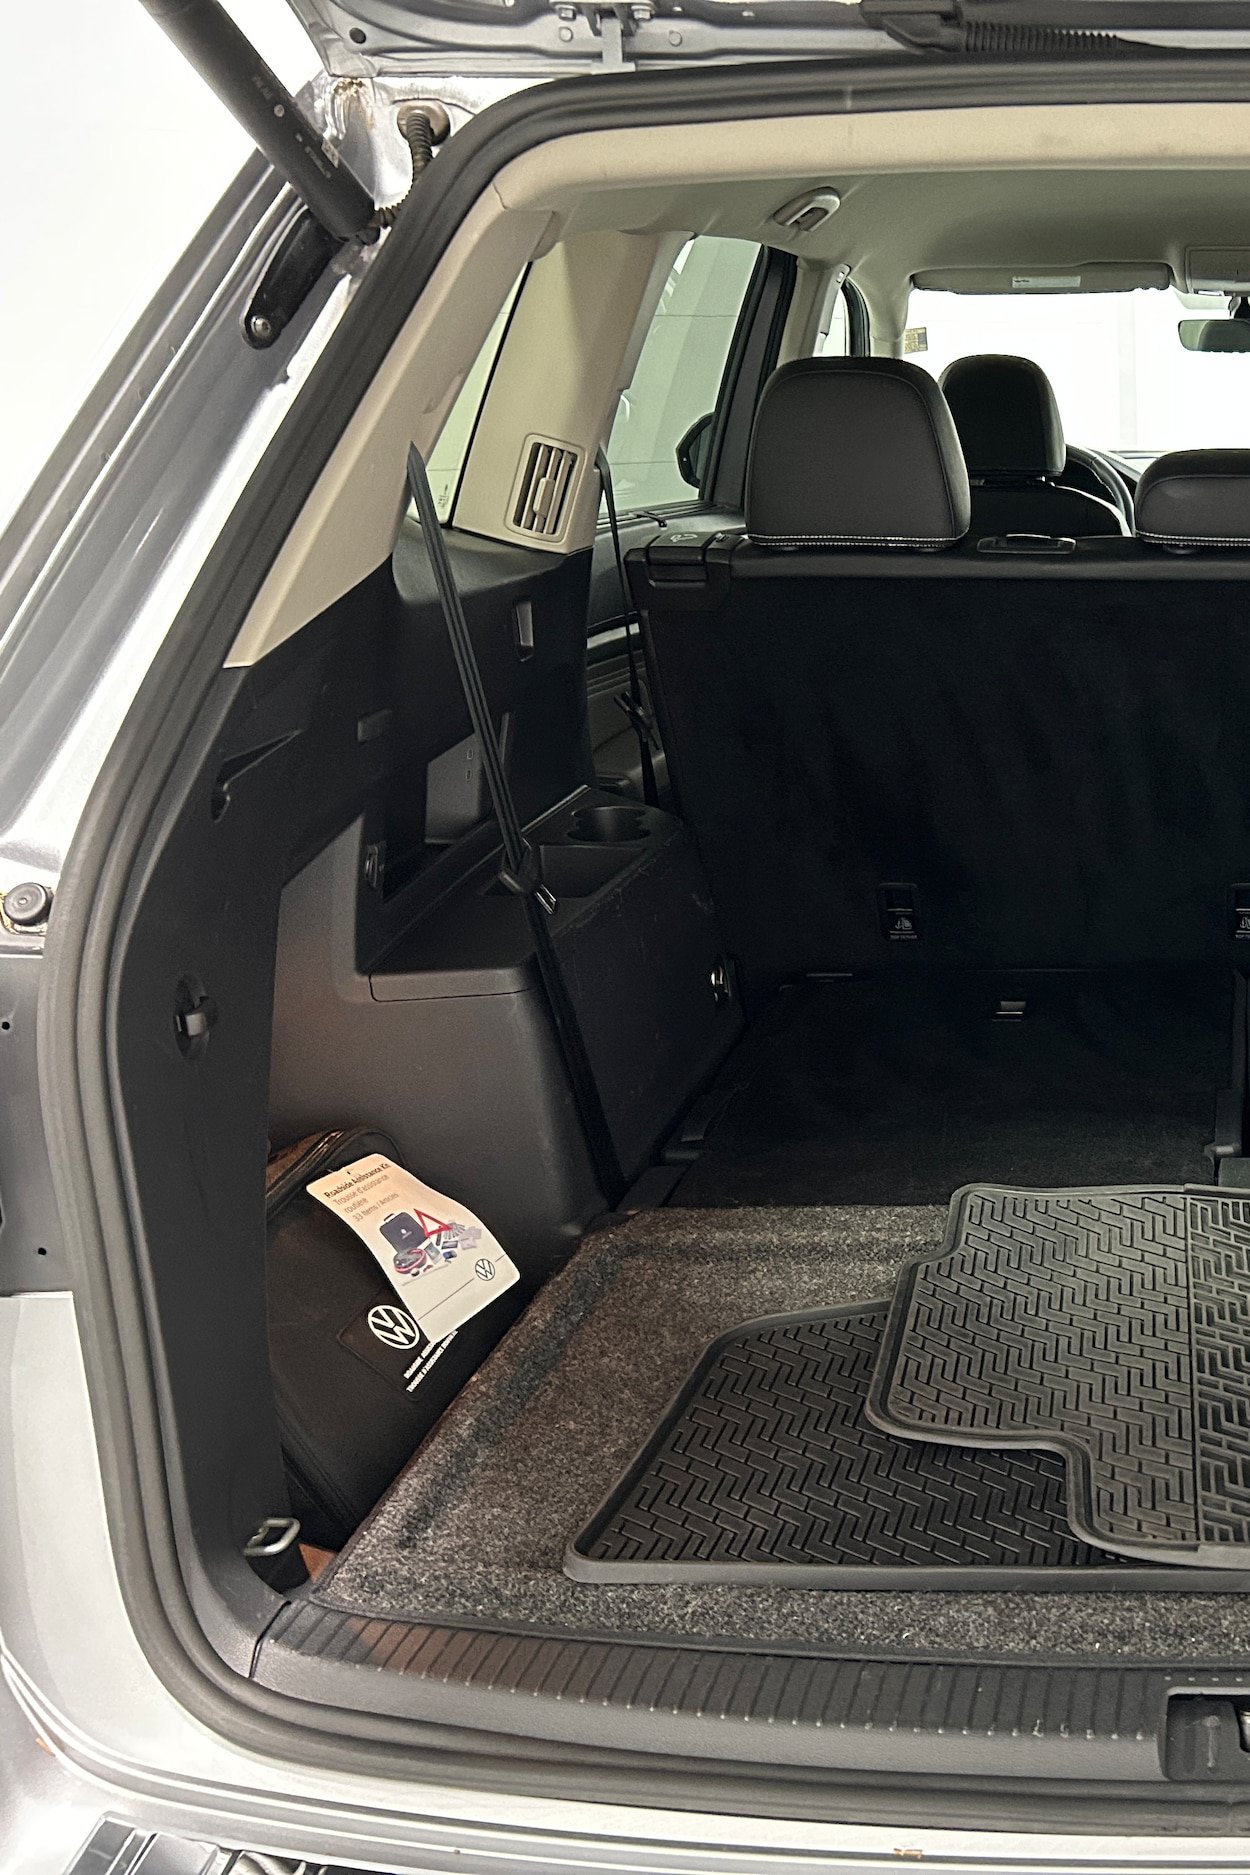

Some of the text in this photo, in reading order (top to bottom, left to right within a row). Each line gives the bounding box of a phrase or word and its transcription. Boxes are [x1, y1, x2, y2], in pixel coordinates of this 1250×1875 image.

[324, 1181, 354, 1198] Roadside
[351, 1167, 382, 1184] Assistance
[332, 1190, 358, 1205] Trousse
[352, 1213, 364, 1222] 33
